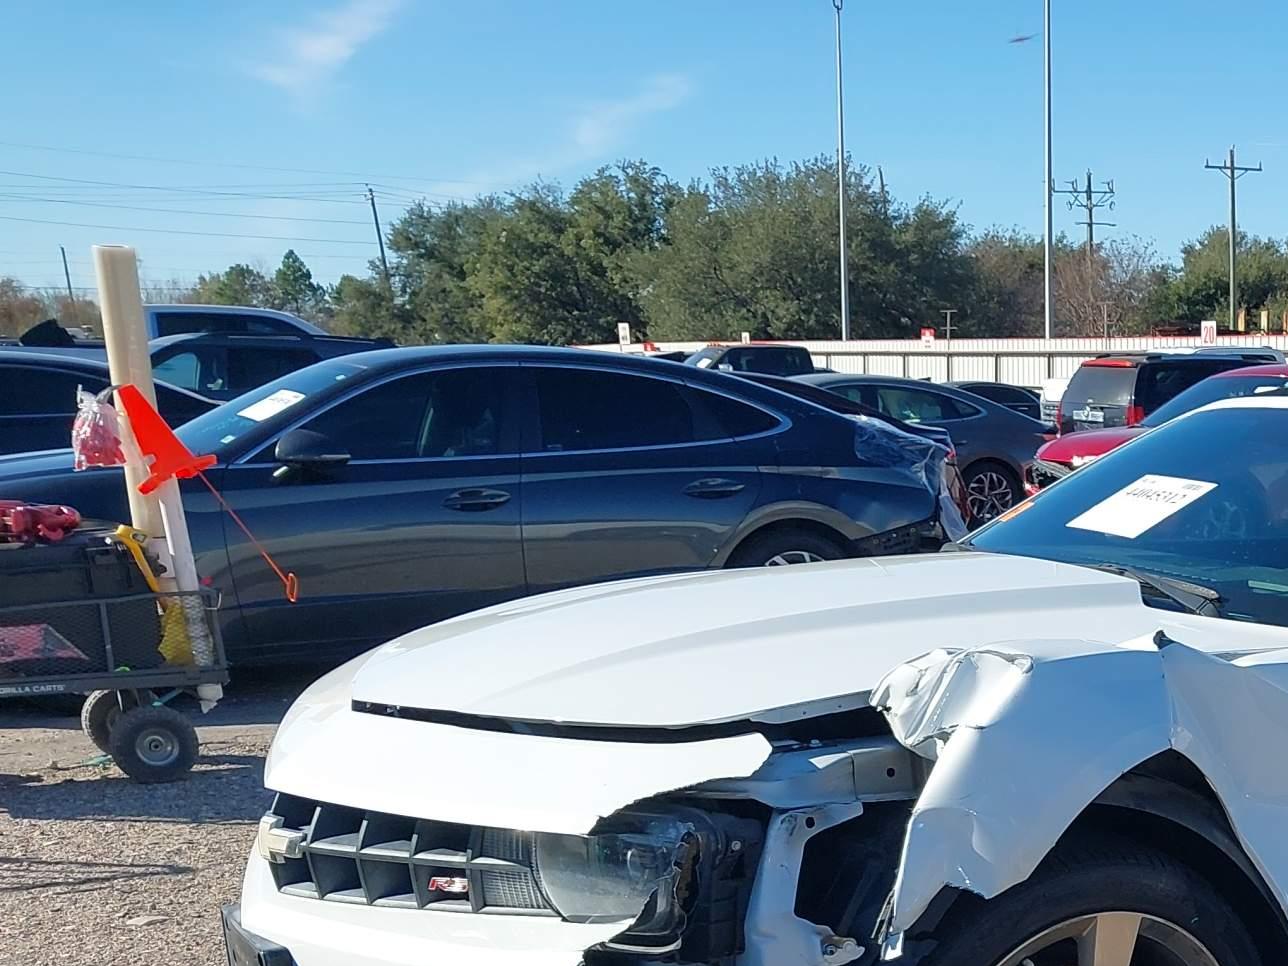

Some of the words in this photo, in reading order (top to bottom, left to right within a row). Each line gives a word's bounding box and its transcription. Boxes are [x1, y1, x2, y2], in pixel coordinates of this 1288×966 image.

[1203, 325, 1215, 344] 20
[32, 684, 65, 693] CARTS
[428, 876, 469, 893] RS
